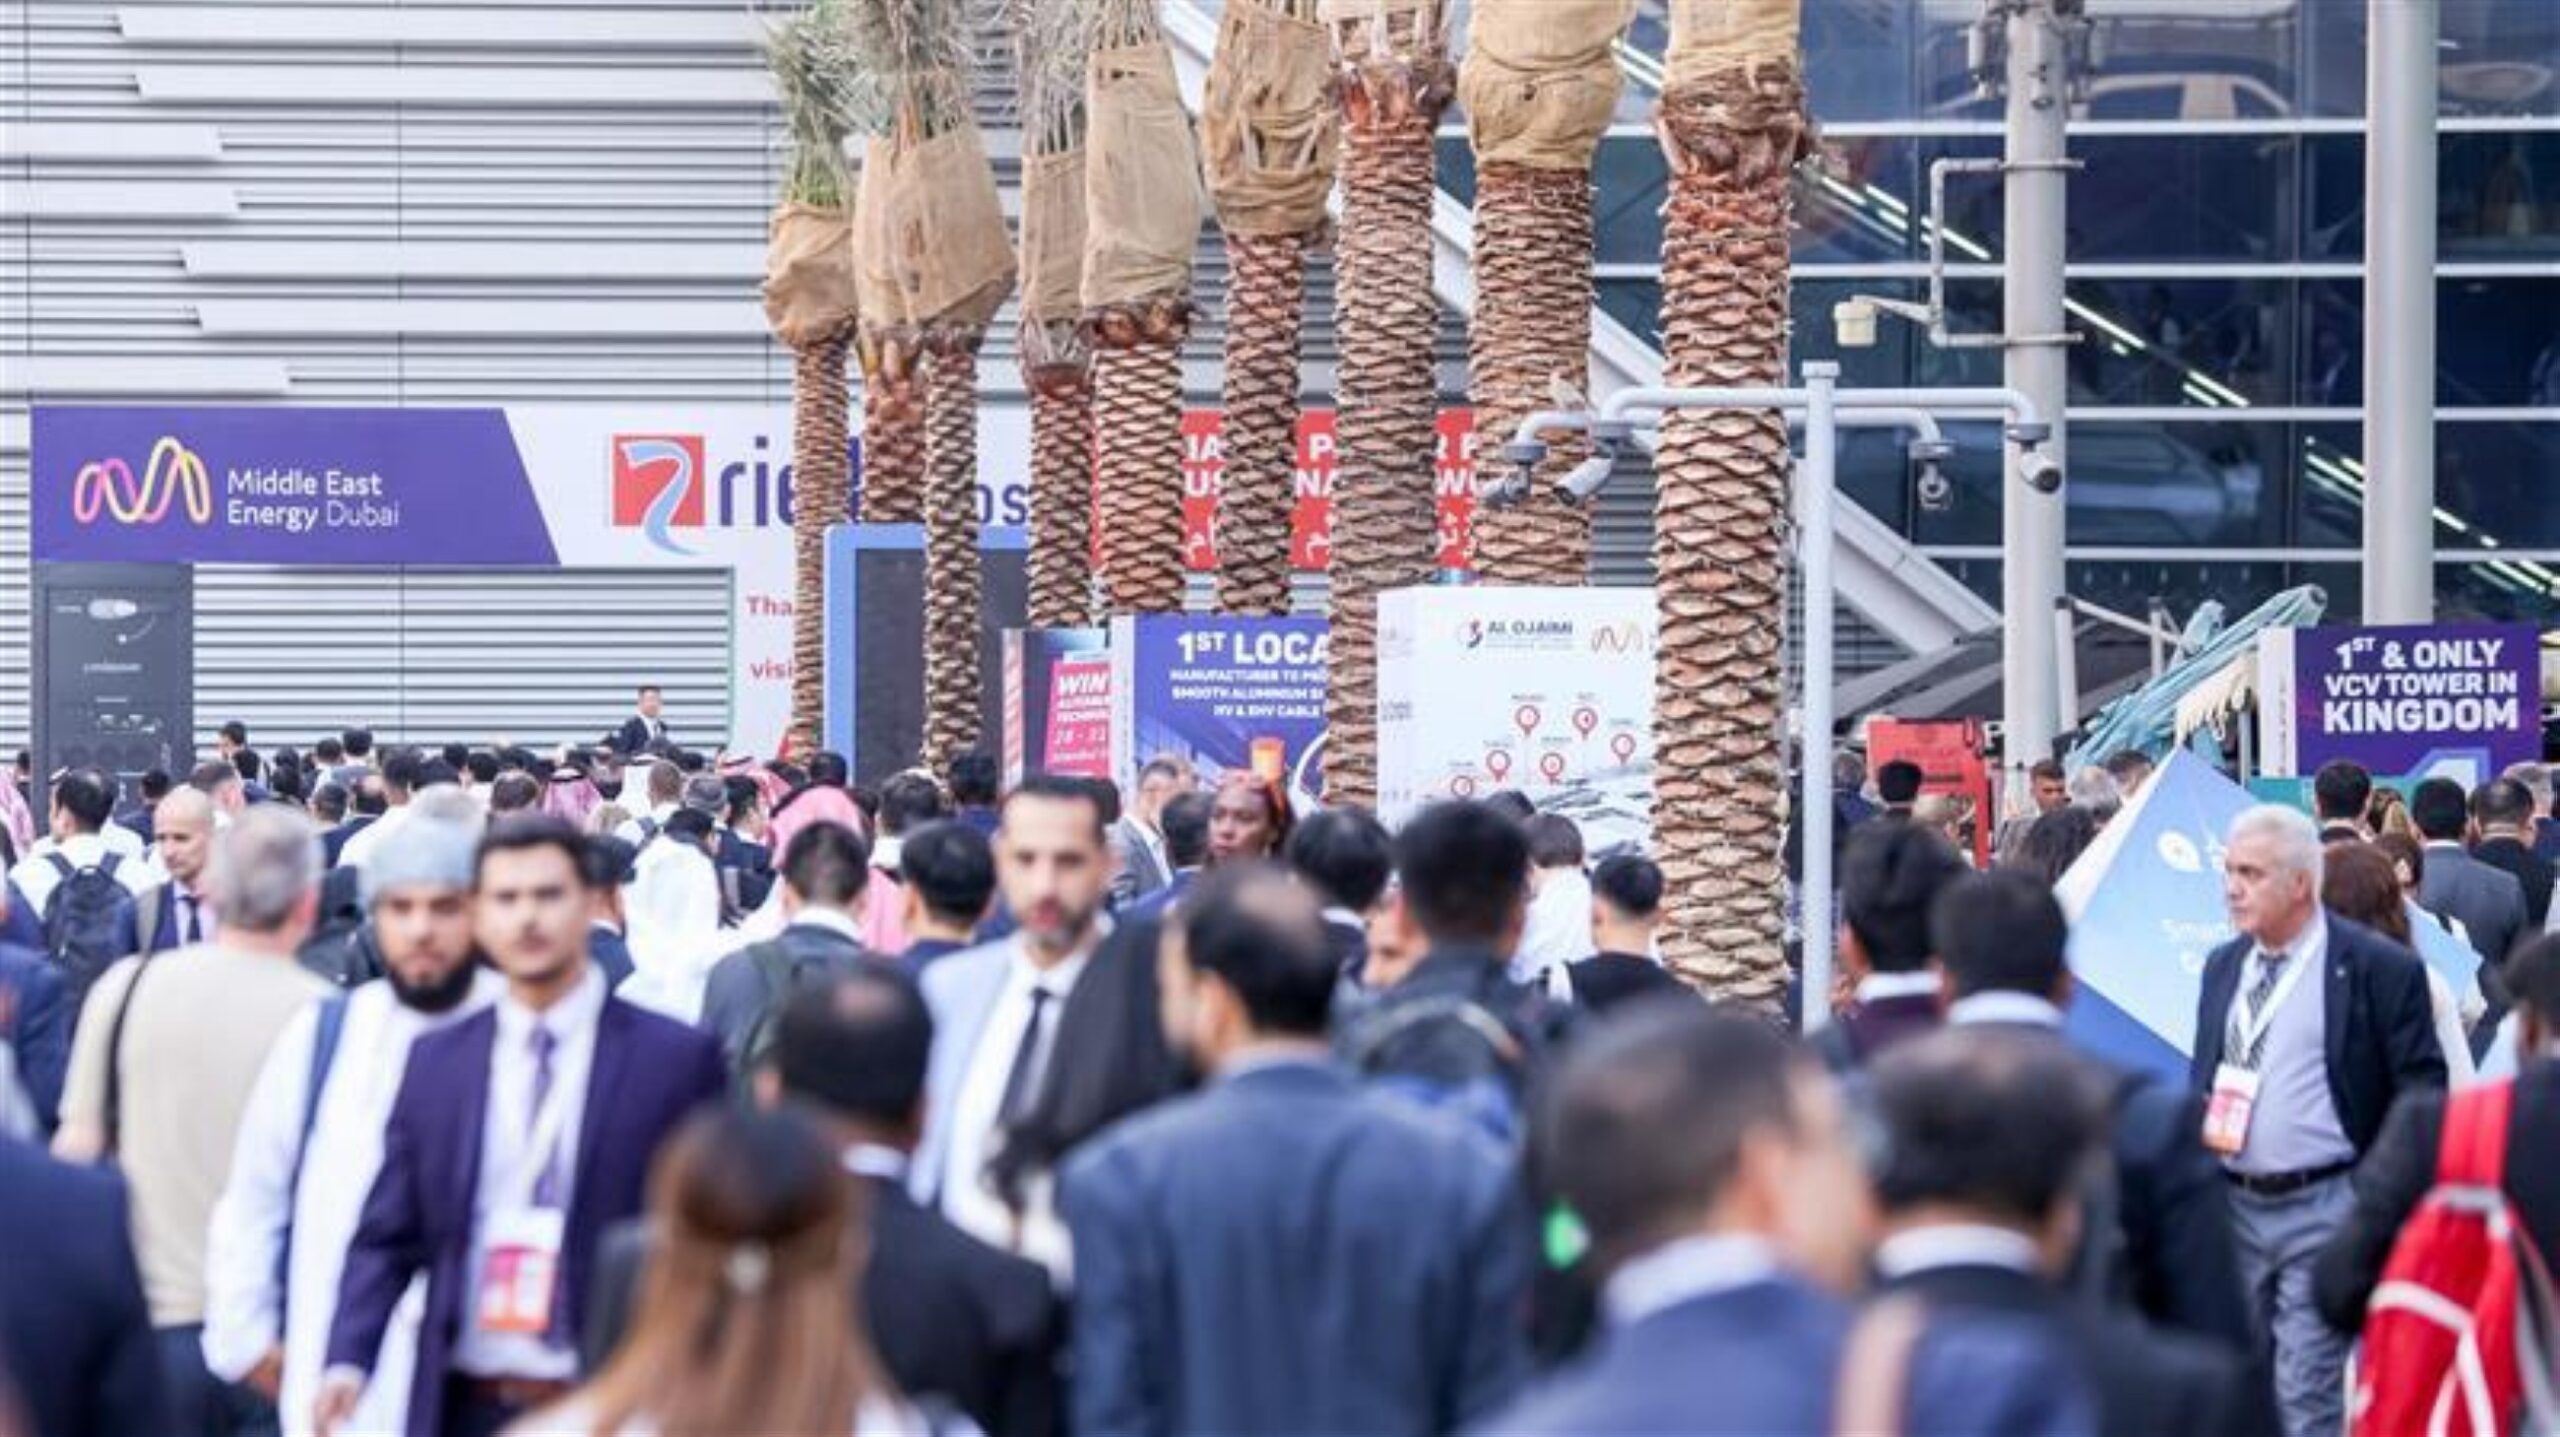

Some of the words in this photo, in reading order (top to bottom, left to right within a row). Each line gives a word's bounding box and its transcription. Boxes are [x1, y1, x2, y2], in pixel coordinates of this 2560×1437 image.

[227, 468, 318, 495] Middle
[326, 471, 383, 495] East
[227, 500, 319, 531] Energy
[326, 500, 400, 526] Dubai
[746, 596, 794, 616] Tha
[1177, 630, 1227, 663] 1ST
[1234, 632, 1329, 664] LOCA
[2336, 638, 2376, 669] 1ST
[2382, 641, 2407, 668] &
[2413, 639, 2503, 668] ONLY
[749, 660, 794, 679] visi
[2324, 674, 2381, 696] VCV
[2386, 673, 2483, 695] TOWER
[2489, 672, 2518, 693] IN
[2323, 698, 2519, 733] KINGDOM
